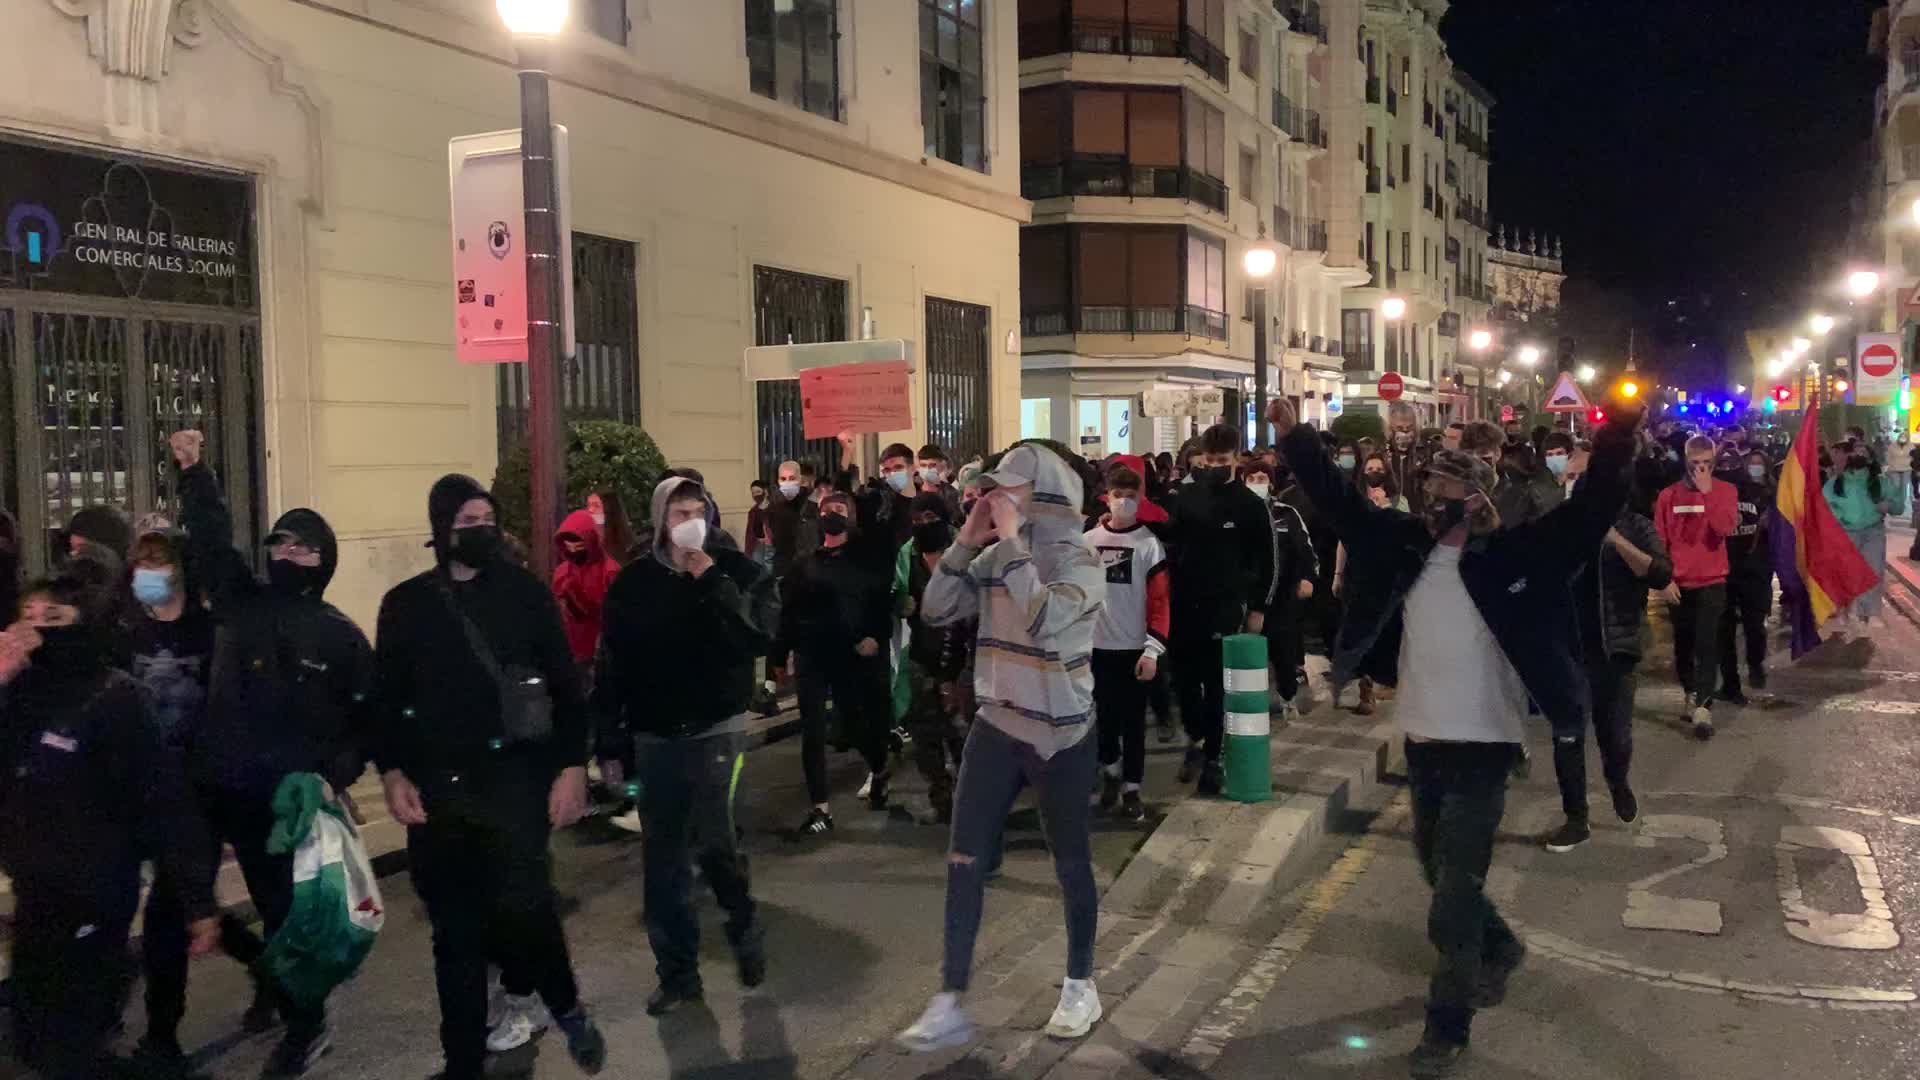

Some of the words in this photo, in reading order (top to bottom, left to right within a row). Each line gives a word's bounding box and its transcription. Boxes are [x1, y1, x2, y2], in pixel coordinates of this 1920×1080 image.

[74, 221, 144, 245] CENRAL
[148, 231, 168, 247] DE
[173, 234, 236, 257] GALERIAS
[75, 245, 183, 273] COMERCALES
[1621, 814, 1901, 950] 20
